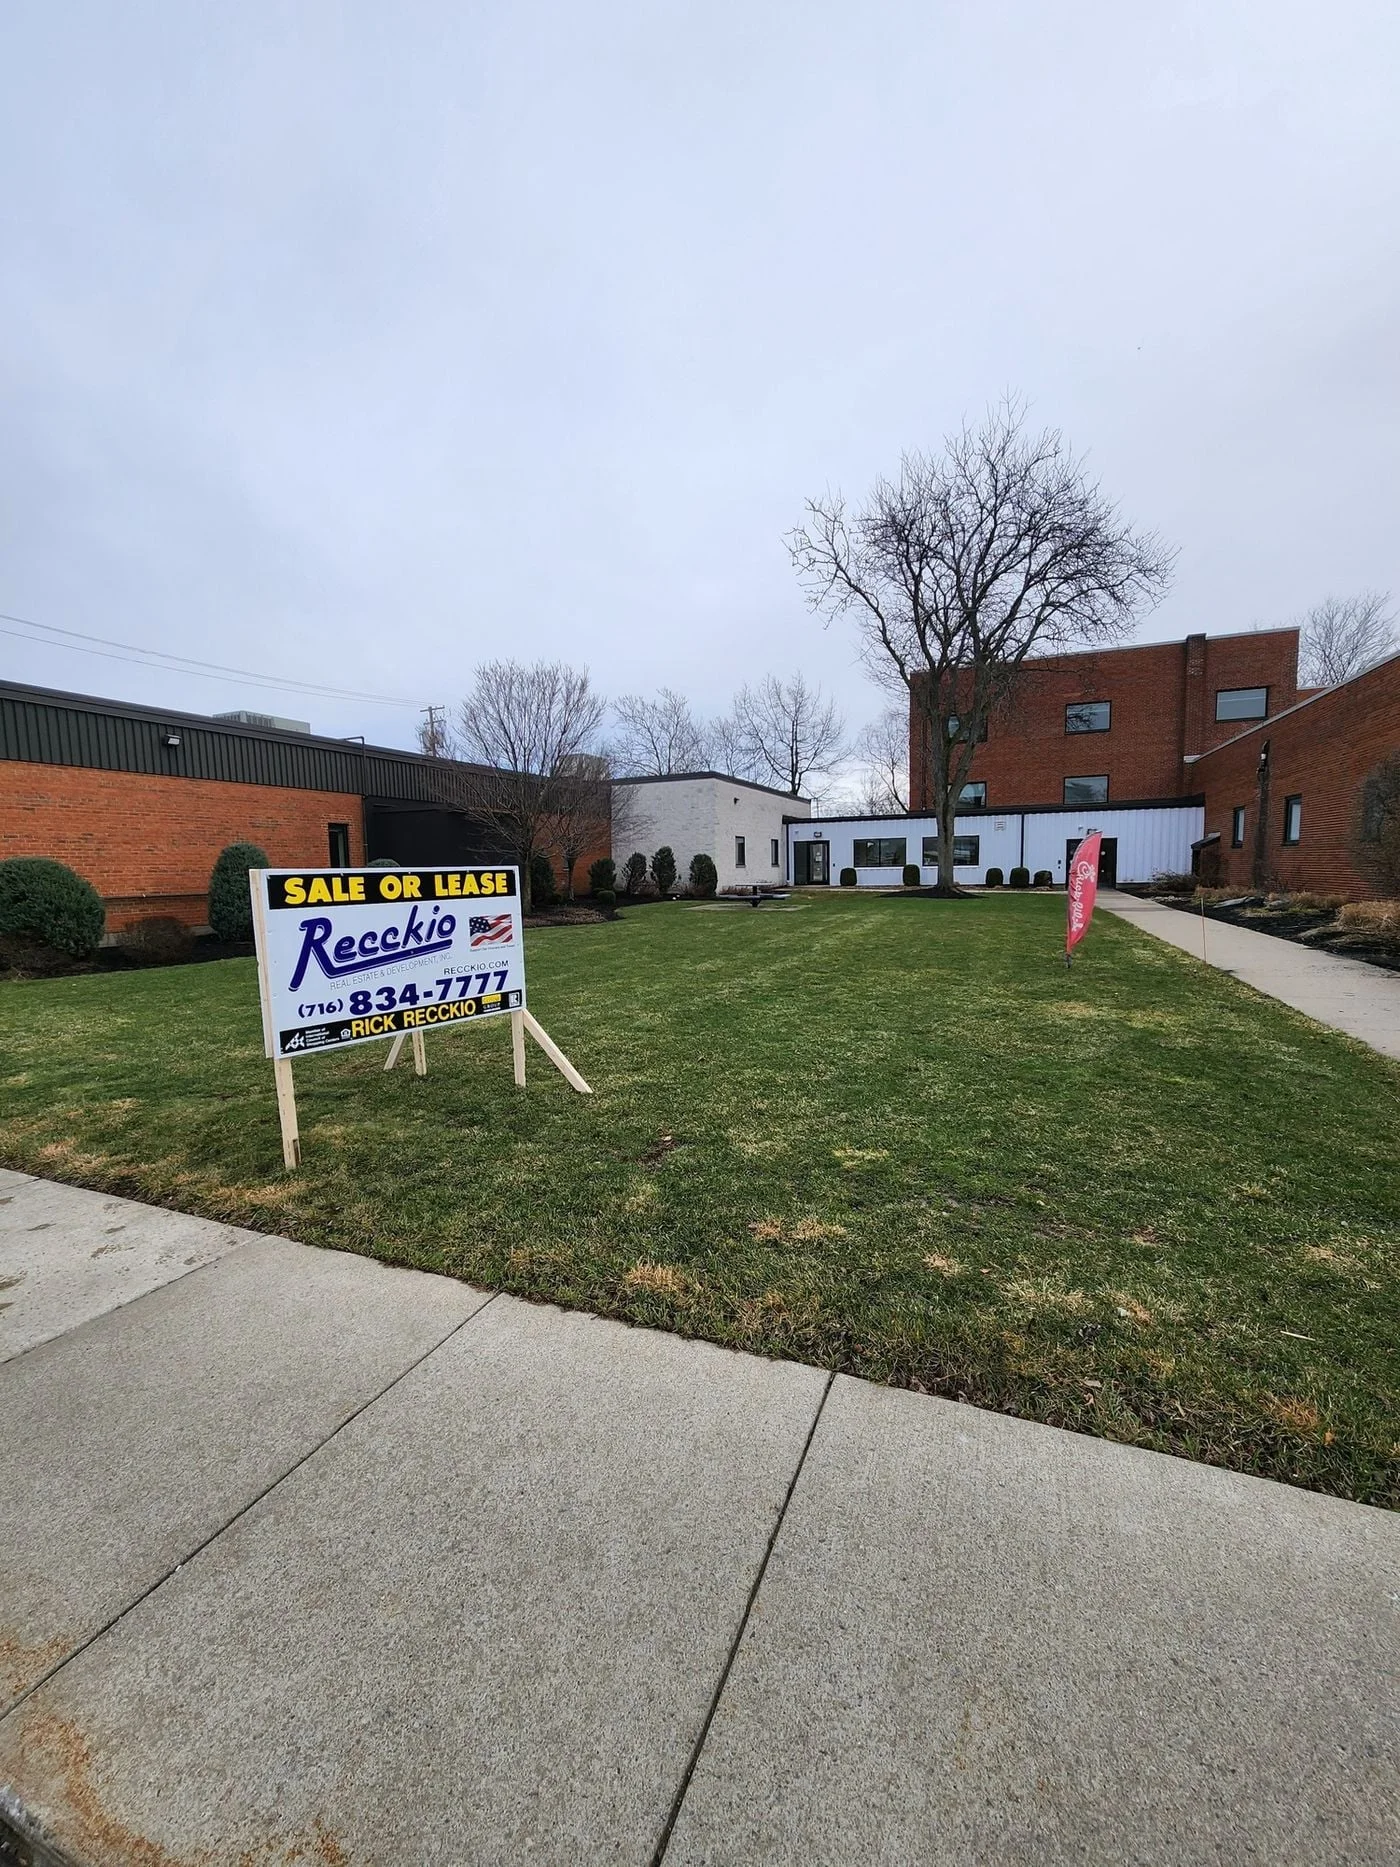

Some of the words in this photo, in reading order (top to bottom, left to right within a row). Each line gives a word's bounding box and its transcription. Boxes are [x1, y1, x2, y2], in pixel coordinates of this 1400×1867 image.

[284, 876, 366, 905] SALE
[379, 875, 422, 900] OR
[435, 872, 508, 897] LEASE
[288, 904, 457, 992] Recckio
[330, 978, 351, 991] REAL
[353, 971, 379, 985] ESTATE
[387, 956, 438, 976] DEVELOPMENT,
[443, 960, 509, 975] RECCKIO.COM
[298, 998, 344, 1019] (716)
[349, 970, 508, 1016] 834-7777
[351, 1014, 397, 1038] RICK
[403, 1000, 476, 1028] RECCKIO
